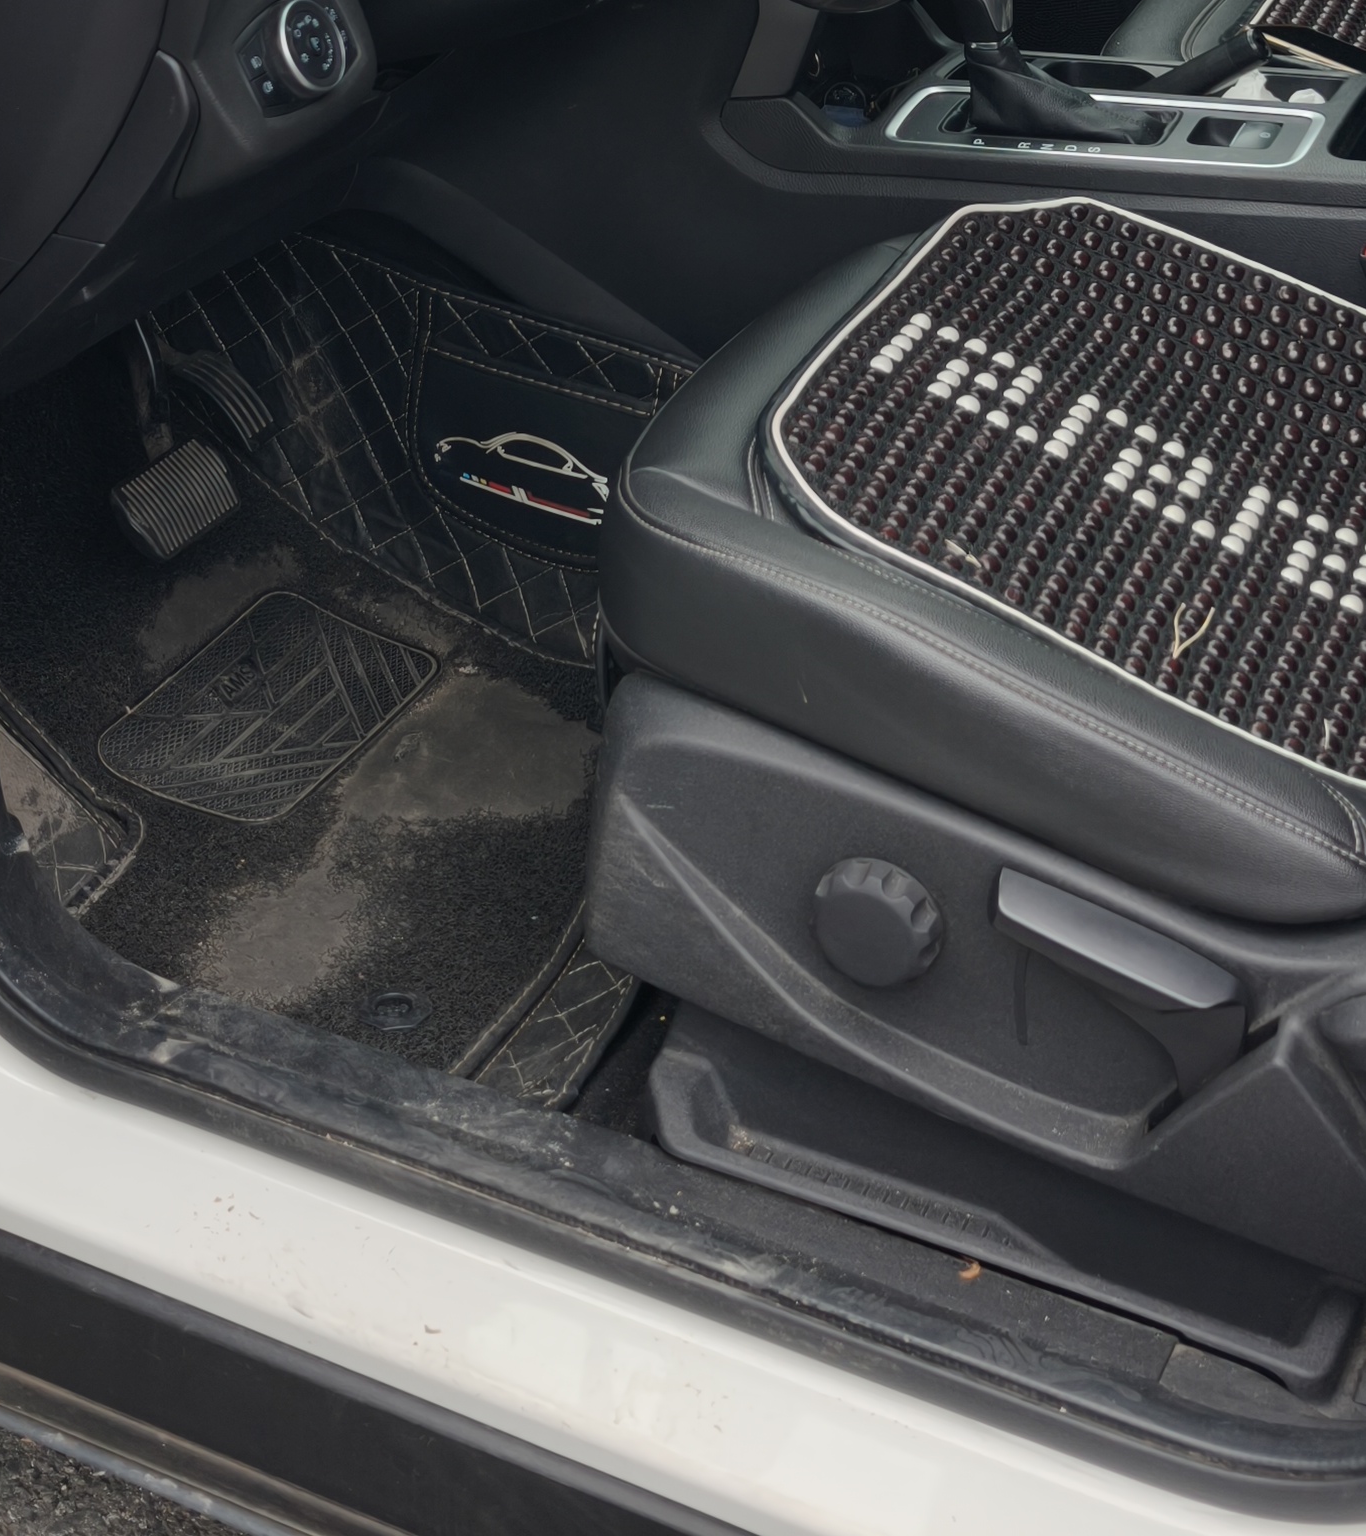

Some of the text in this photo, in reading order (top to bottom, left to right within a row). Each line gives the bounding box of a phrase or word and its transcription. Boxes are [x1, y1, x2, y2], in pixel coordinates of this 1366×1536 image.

[1017, 141, 1032, 149] R
[1040, 143, 1055, 151] N
[1064, 144, 1077, 152] D
